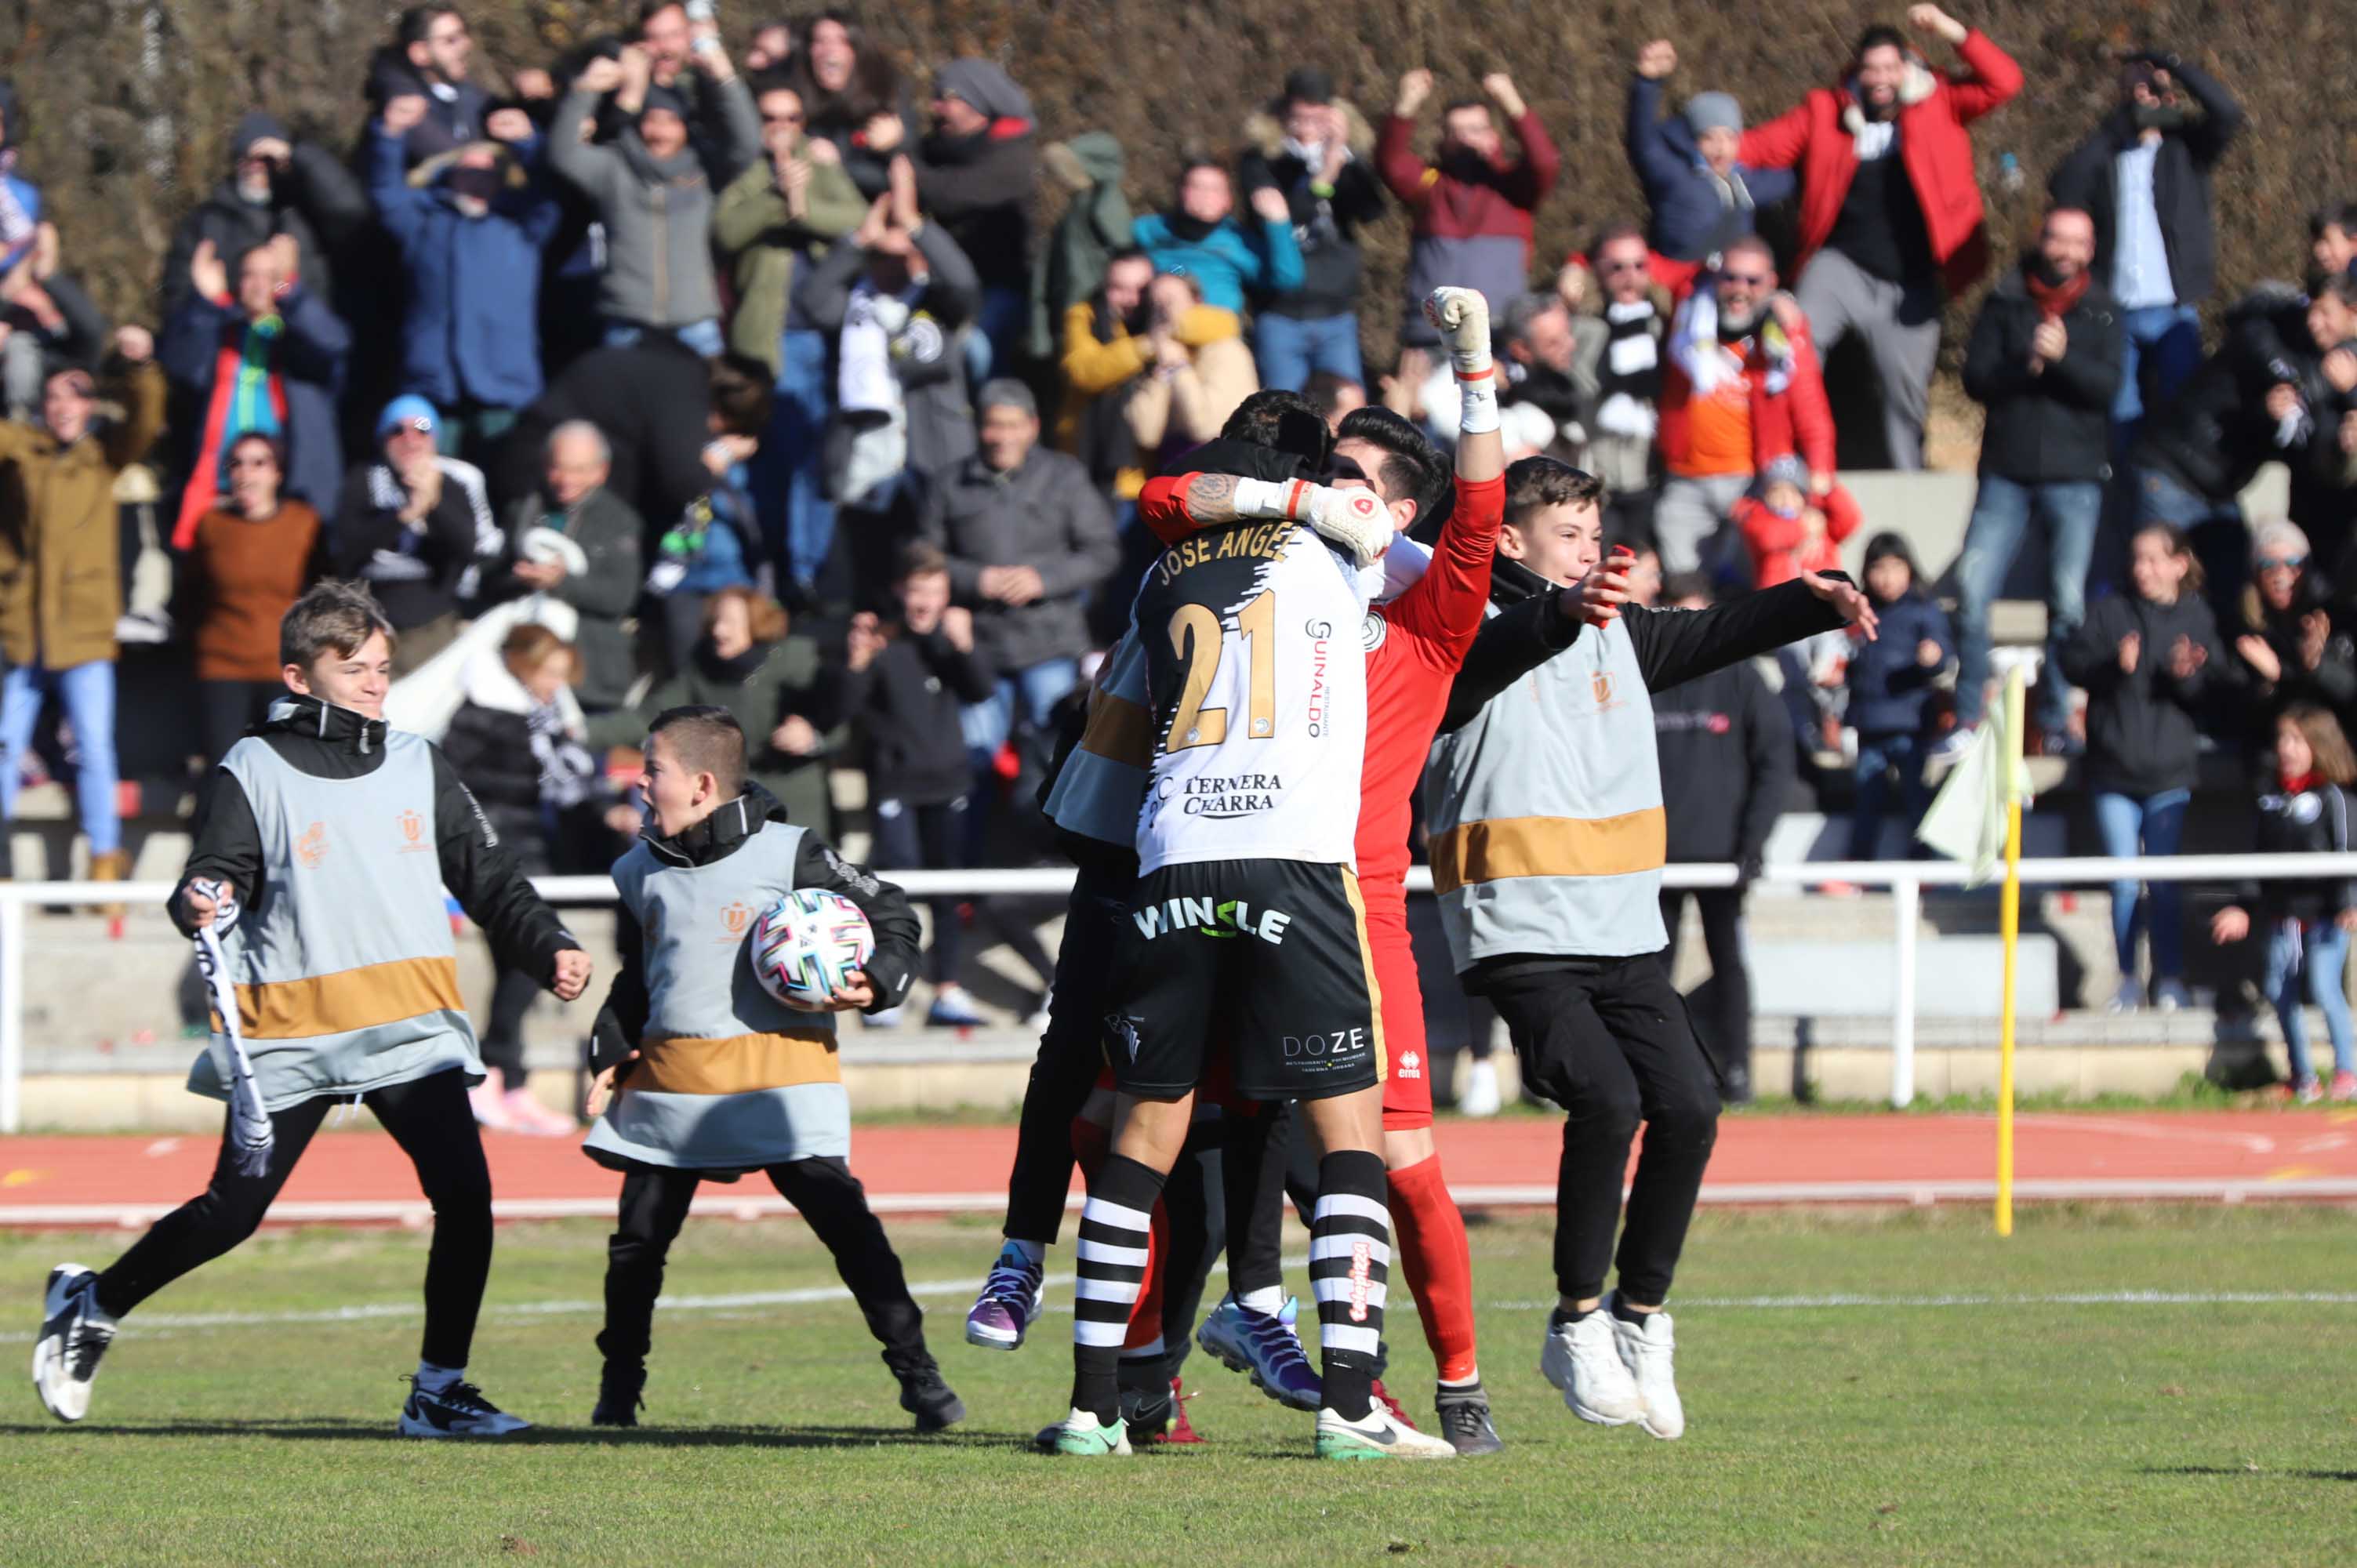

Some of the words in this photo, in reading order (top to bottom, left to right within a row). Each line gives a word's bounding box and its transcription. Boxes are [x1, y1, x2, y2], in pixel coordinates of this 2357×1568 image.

[1158, 538, 1211, 586] JOSE
[1215, 521, 1302, 563] ANGEL
[1167, 588, 1276, 753] 21
[1306, 618, 1332, 739] GUINALDO
[1183, 774, 1283, 794] TERNERA
[1183, 795, 1274, 815] CHARRA
[1283, 1027, 1364, 1057] DOZE
